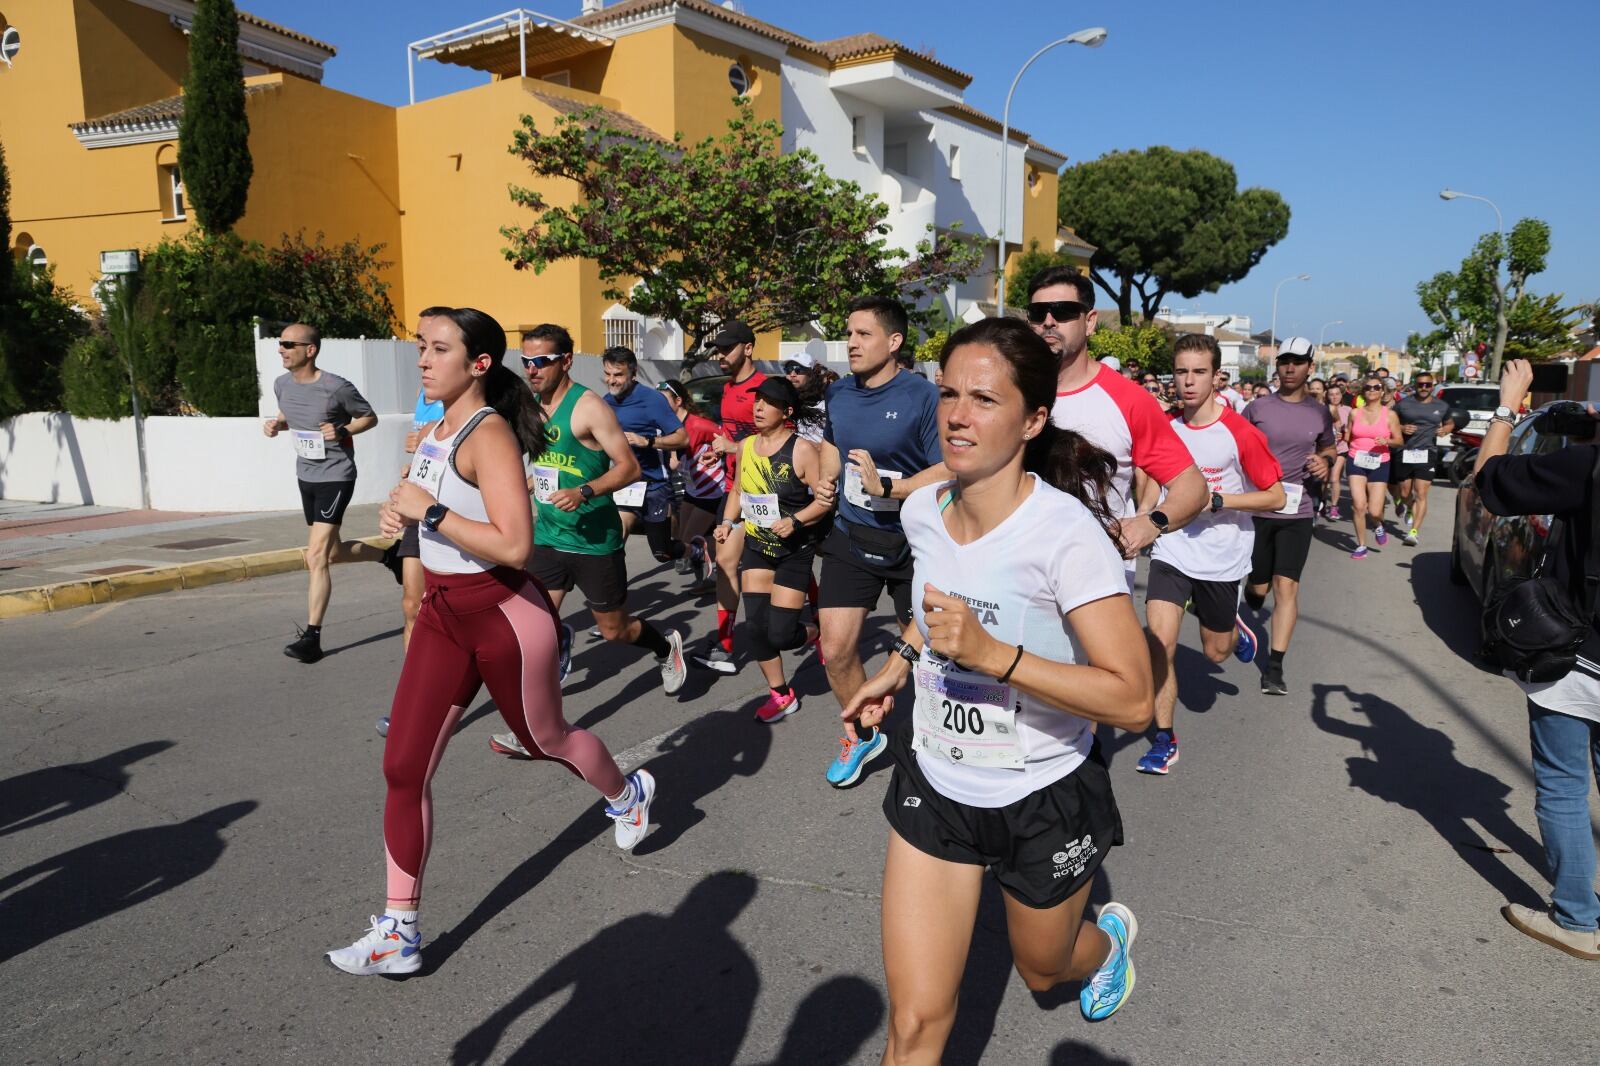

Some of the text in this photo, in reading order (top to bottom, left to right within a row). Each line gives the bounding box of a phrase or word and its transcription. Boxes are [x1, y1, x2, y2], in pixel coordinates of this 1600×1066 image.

[417, 458, 431, 479] 95
[536, 478, 549, 491] 196
[751, 504, 769, 516] 188
[942, 699, 985, 736] 200
